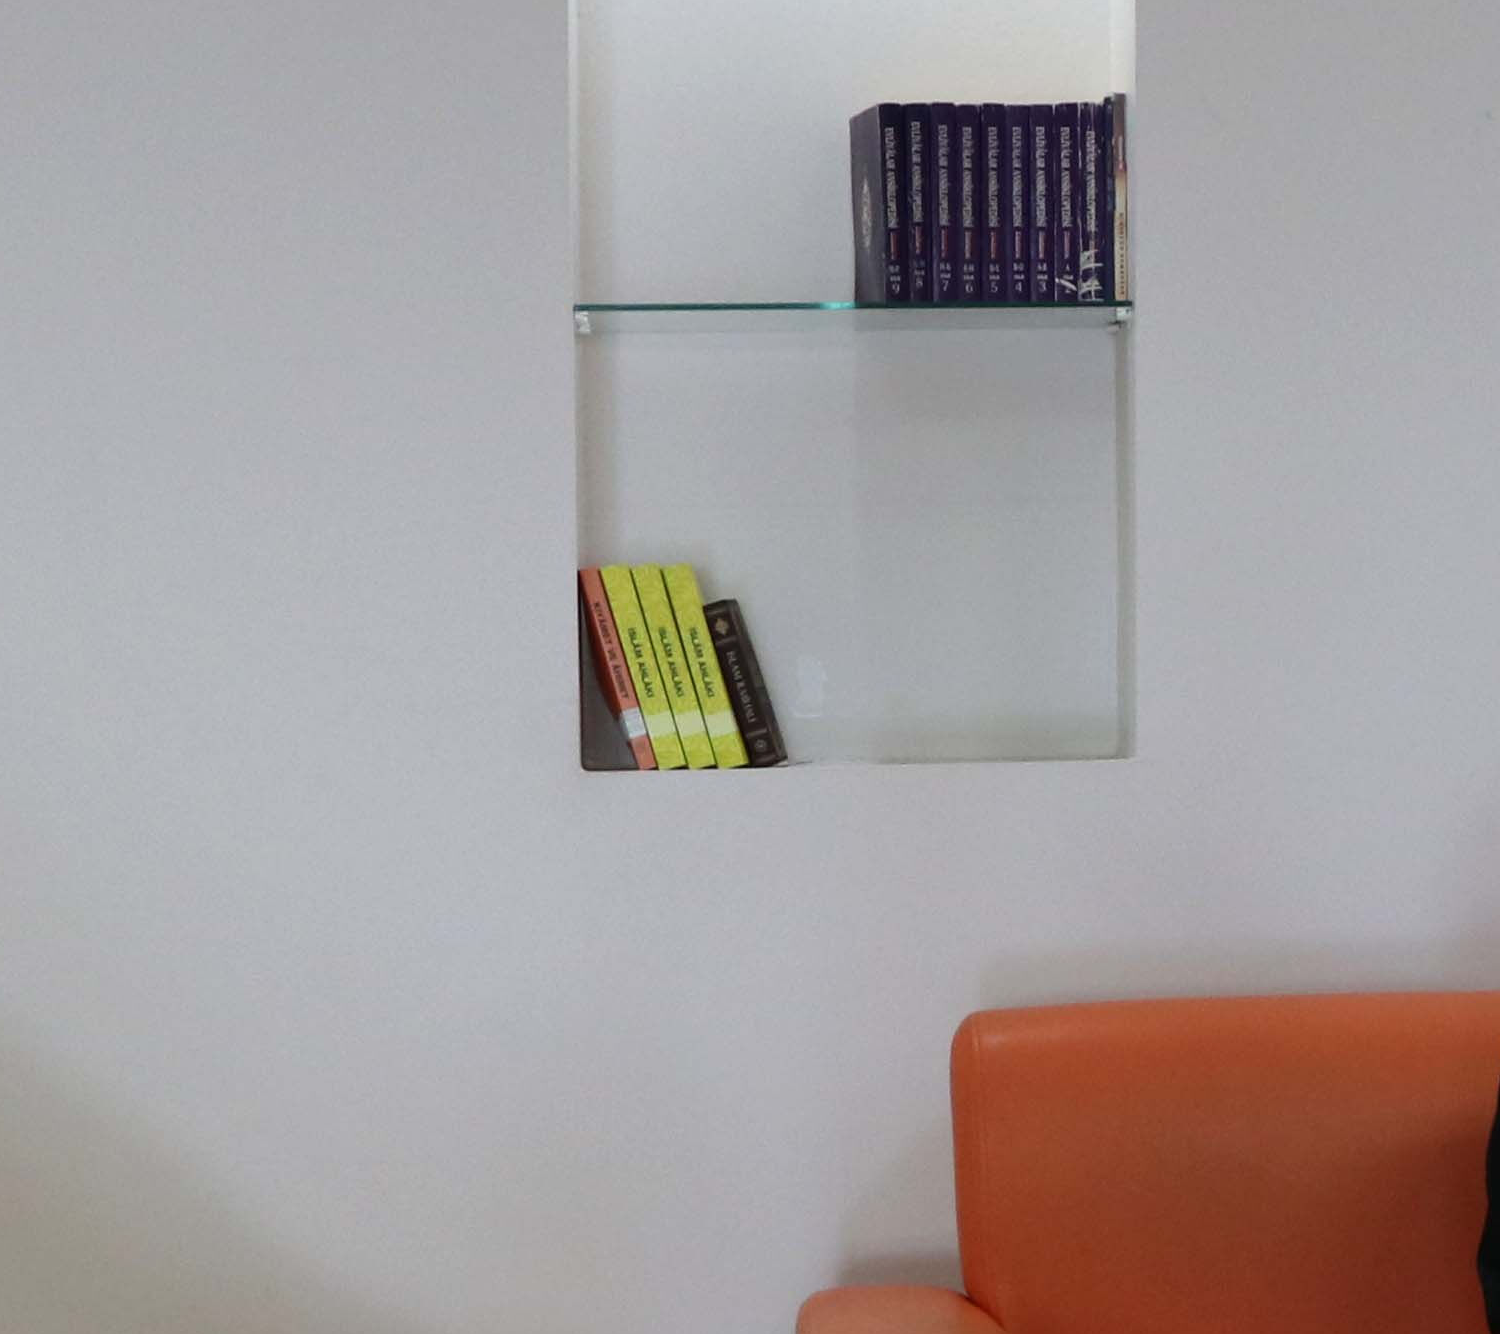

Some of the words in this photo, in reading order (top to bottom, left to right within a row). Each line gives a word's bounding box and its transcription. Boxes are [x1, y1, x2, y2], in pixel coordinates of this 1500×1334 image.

[892, 283, 900, 293] 9
[943, 281, 950, 292] 7
[965, 282, 973, 293] 6
[991, 282, 998, 293] 5
[1015, 281, 1022, 292] 4
[1039, 281, 1046, 293] 3
